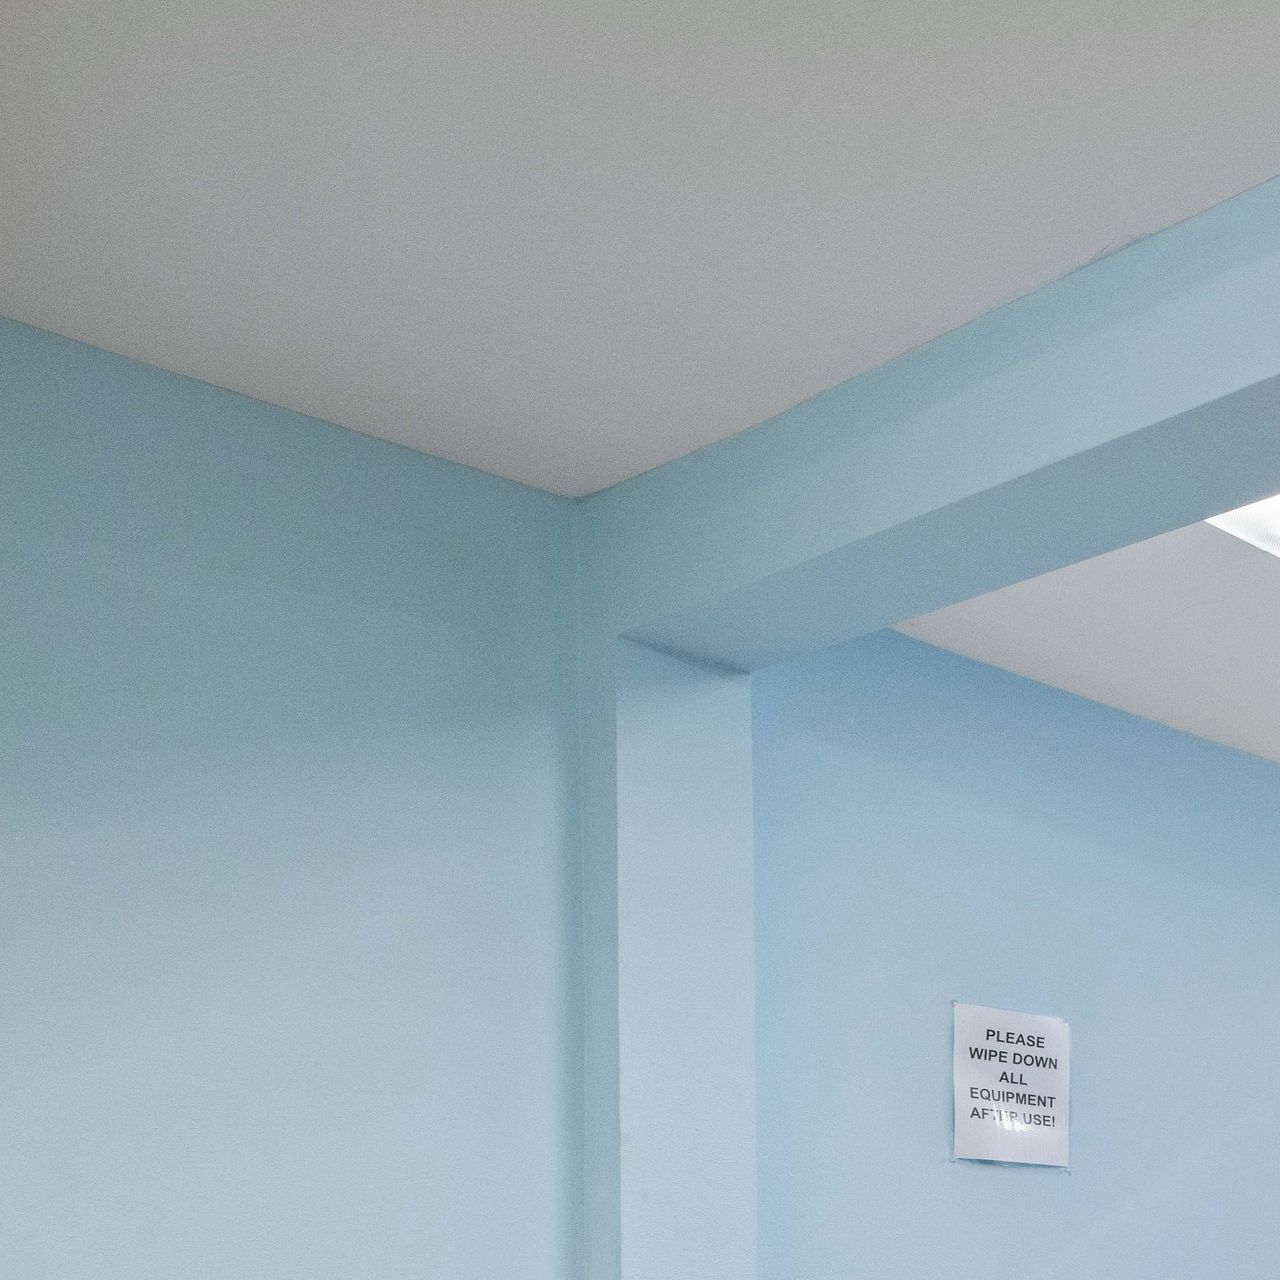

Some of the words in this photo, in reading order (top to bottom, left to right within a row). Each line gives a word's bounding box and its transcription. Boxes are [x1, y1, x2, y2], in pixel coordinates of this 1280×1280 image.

[985, 1028, 1045, 1048] PLEASE
[968, 1046, 1008, 1063] WIPE
[1012, 1052, 1058, 1070] DOWN
[998, 1071, 1028, 1086] ALL
[969, 1087, 1056, 1108] EQUIPMENT
[1023, 1112, 1056, 1128] USE!
